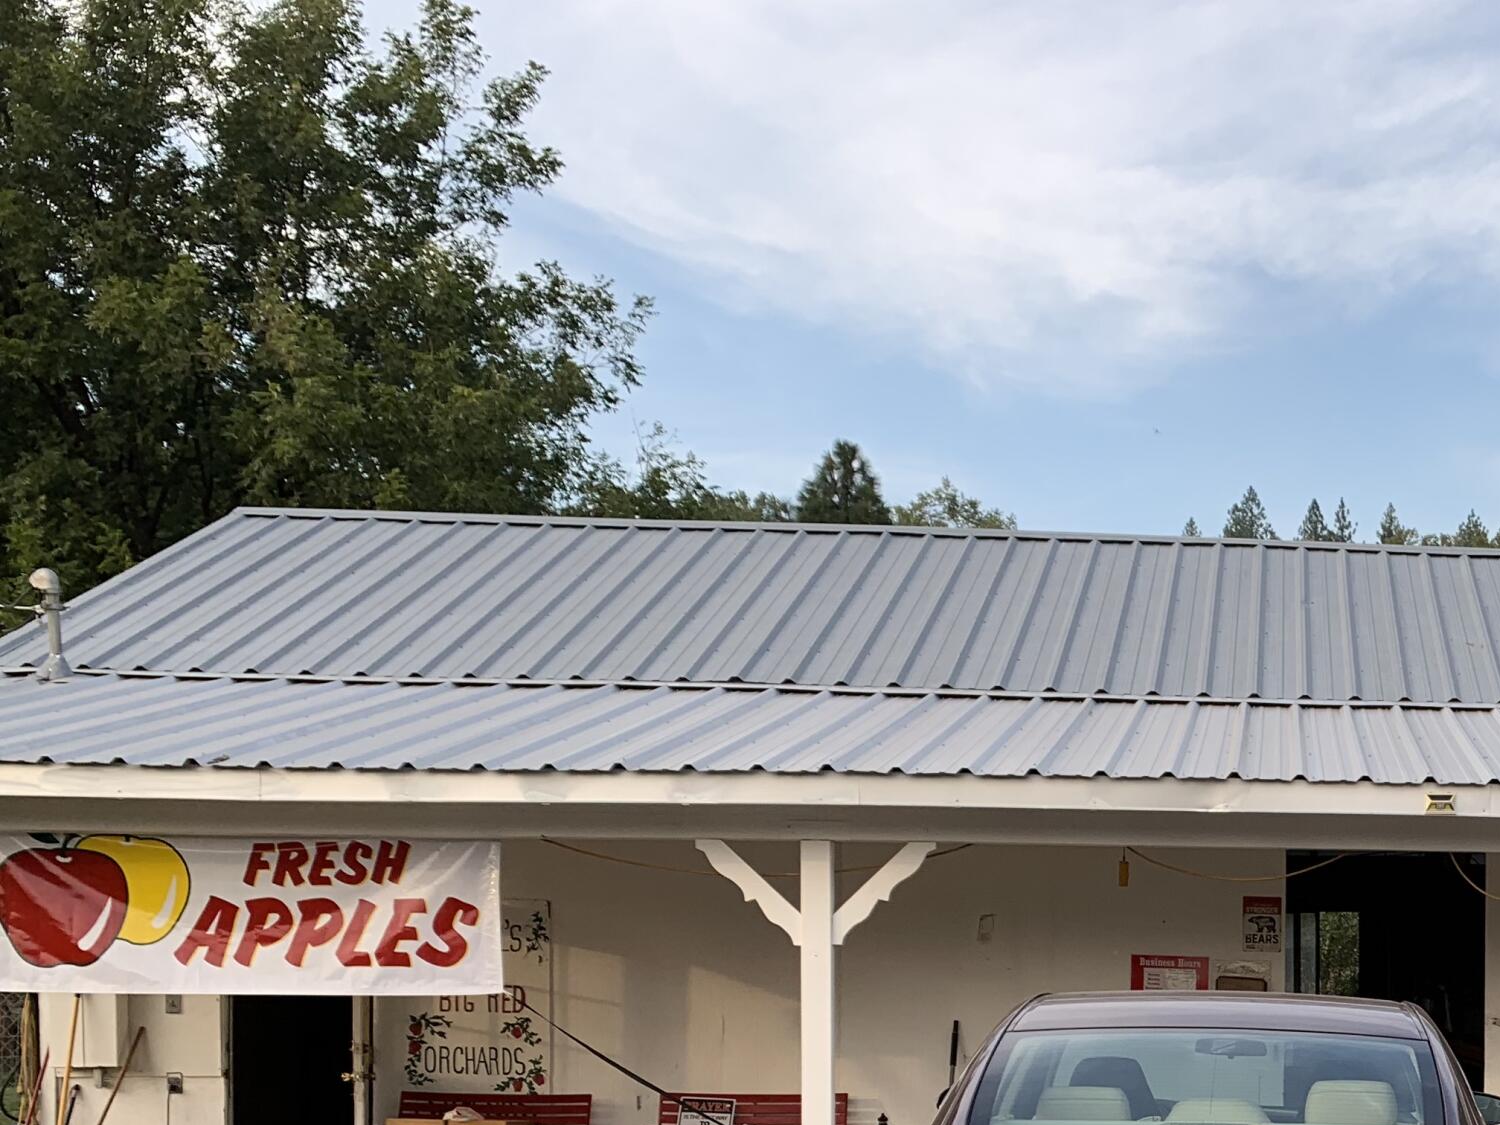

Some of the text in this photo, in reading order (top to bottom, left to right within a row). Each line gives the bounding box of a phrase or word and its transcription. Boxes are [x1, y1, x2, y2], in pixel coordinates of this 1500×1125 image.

[242, 840, 412, 887] FRESH
[173, 896, 480, 968] APPLES
[1245, 934, 1279, 944] BEARS
[1139, 956, 1175, 967] Business
[424, 1046, 526, 1076] ORCHARDS
[685, 1101, 732, 1111] RAYER
